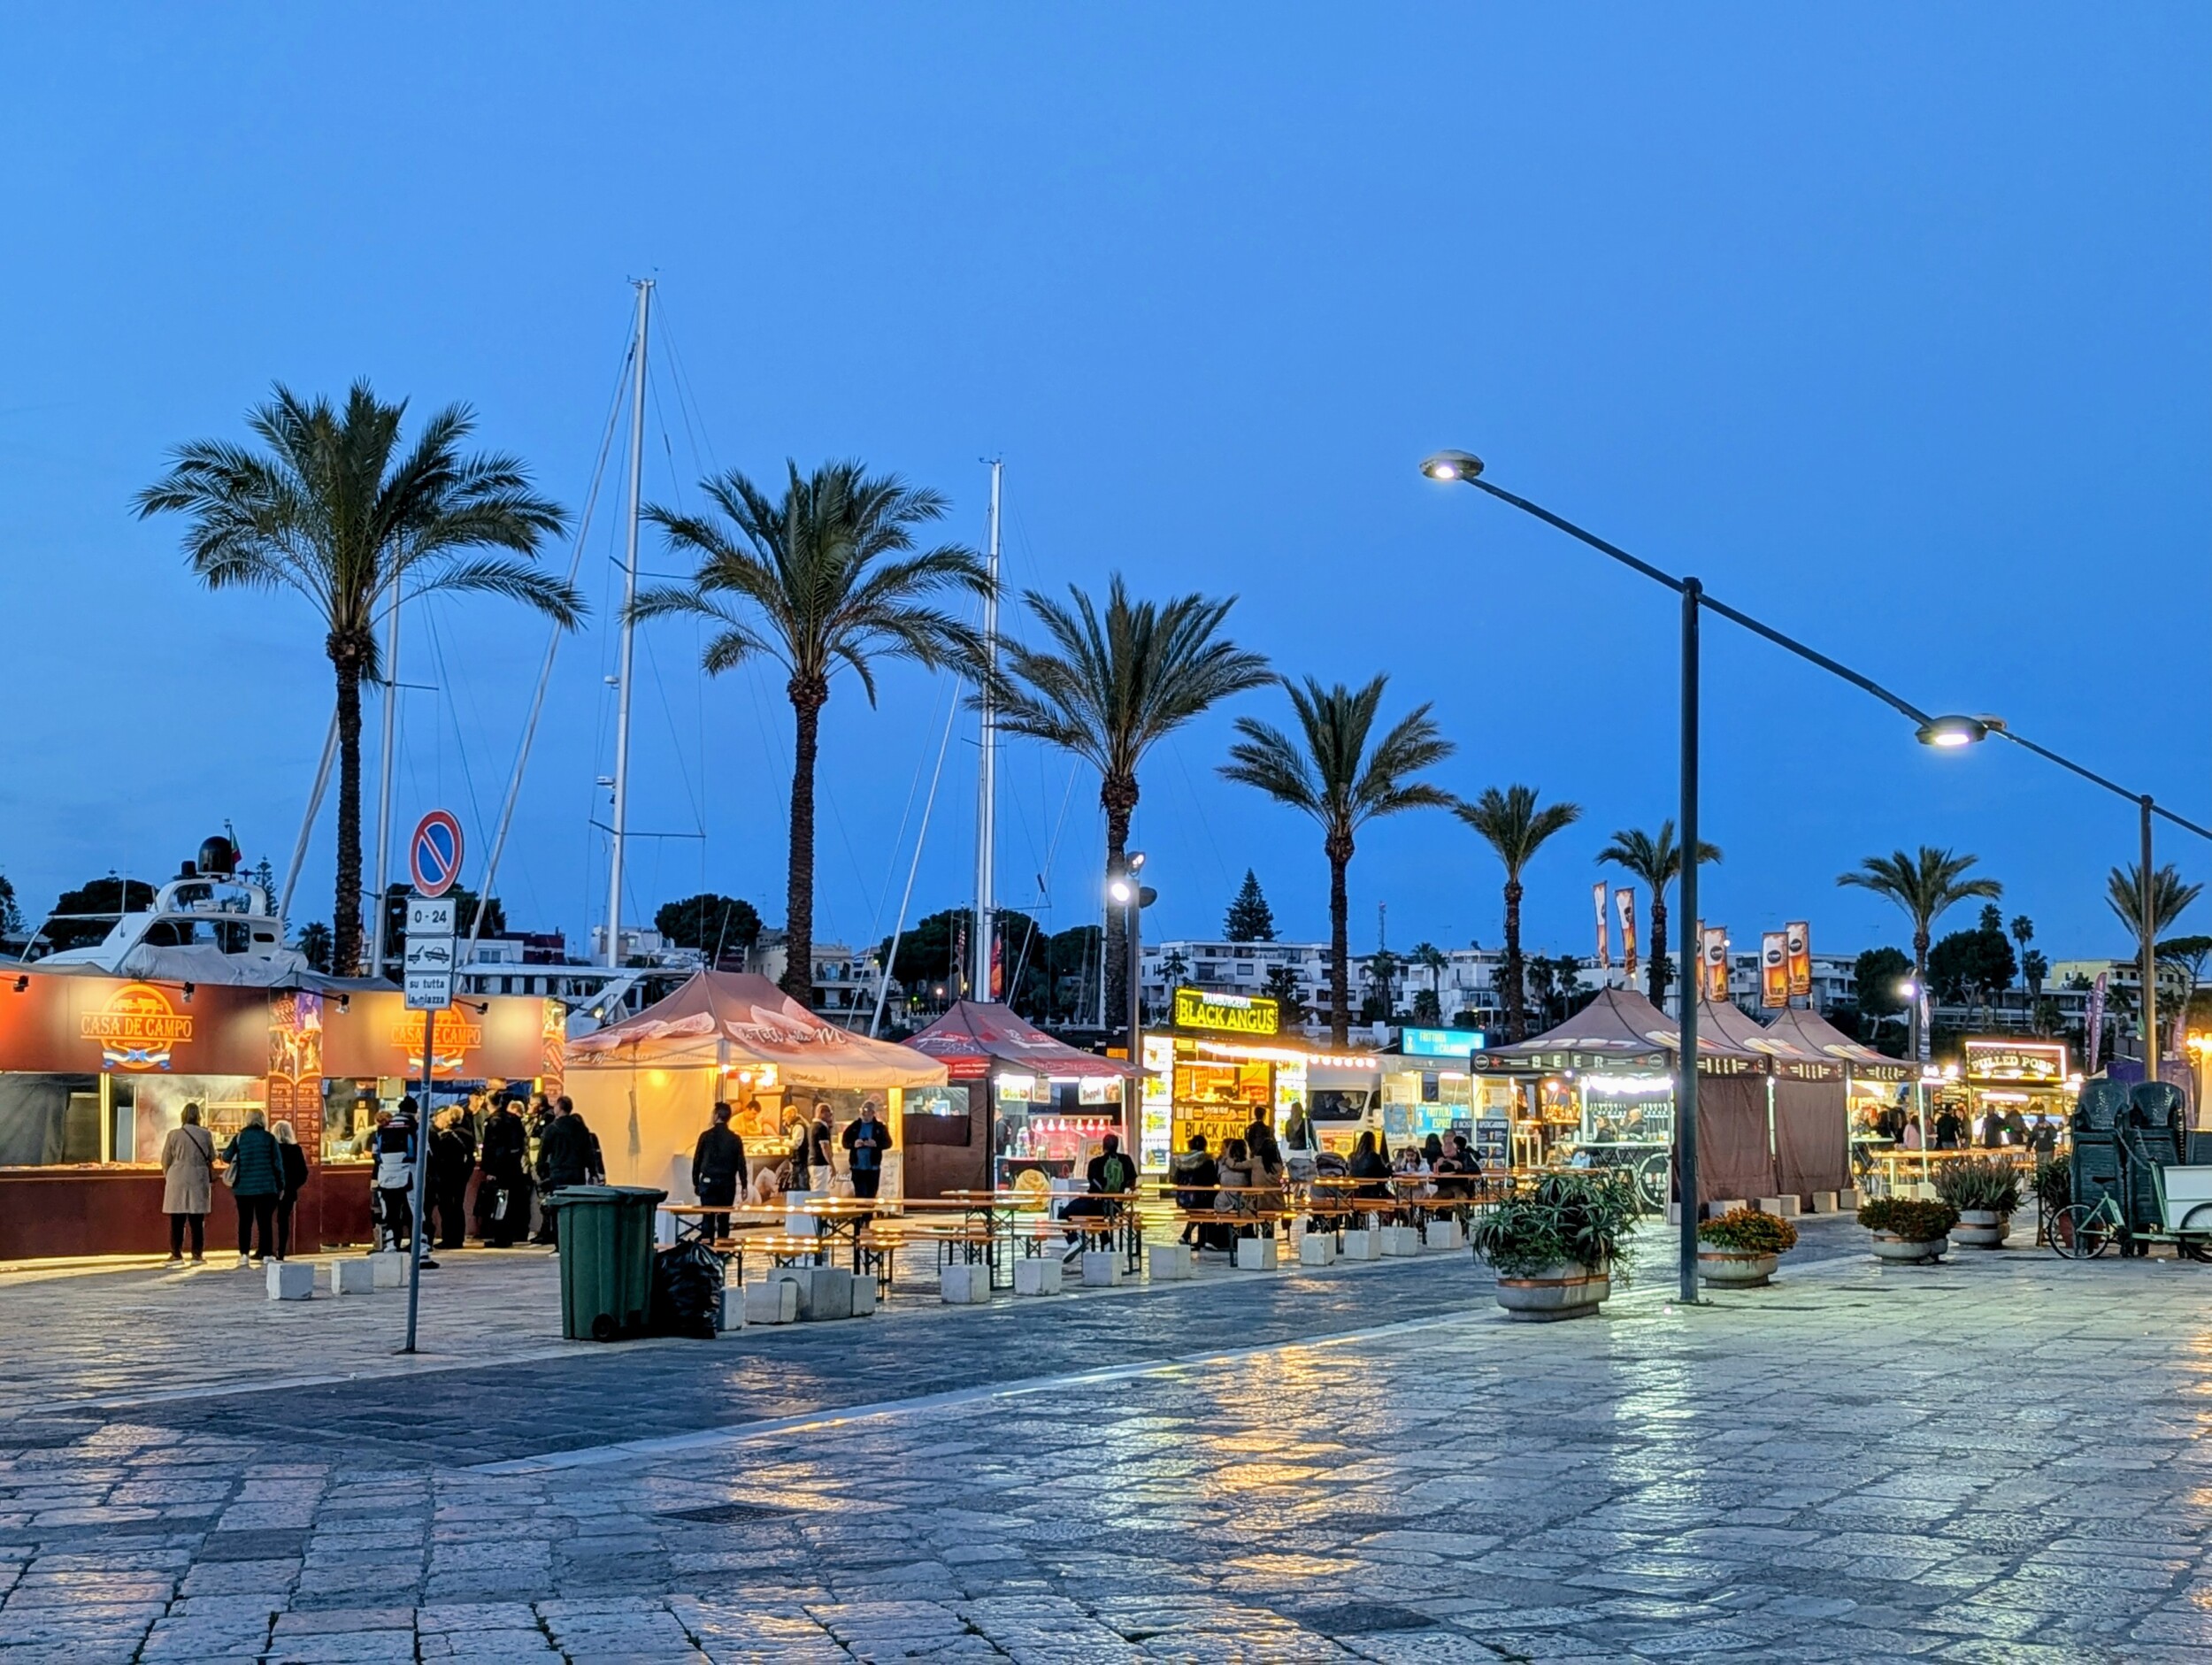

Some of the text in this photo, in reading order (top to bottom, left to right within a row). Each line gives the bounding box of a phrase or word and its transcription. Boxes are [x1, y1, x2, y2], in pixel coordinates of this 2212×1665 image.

[414, 910, 422, 924] 0
[432, 910, 447, 924] 24
[409, 978, 445, 989] su tutta
[1179, 998, 1276, 1031] BLACK ANGUS
[81, 1016, 193, 1038] CASA DE CAMPO
[390, 1026, 422, 1043] CASA
[442, 1027, 481, 1045] CAMPO
[1532, 1055, 1604, 1069] BEER
[1706, 1058, 1738, 1075] BEER
[1971, 1055, 2018, 1071] PULLED
[2022, 1056, 2056, 1074] PORK
[1186, 1122, 1246, 1139] BLACK ANG
